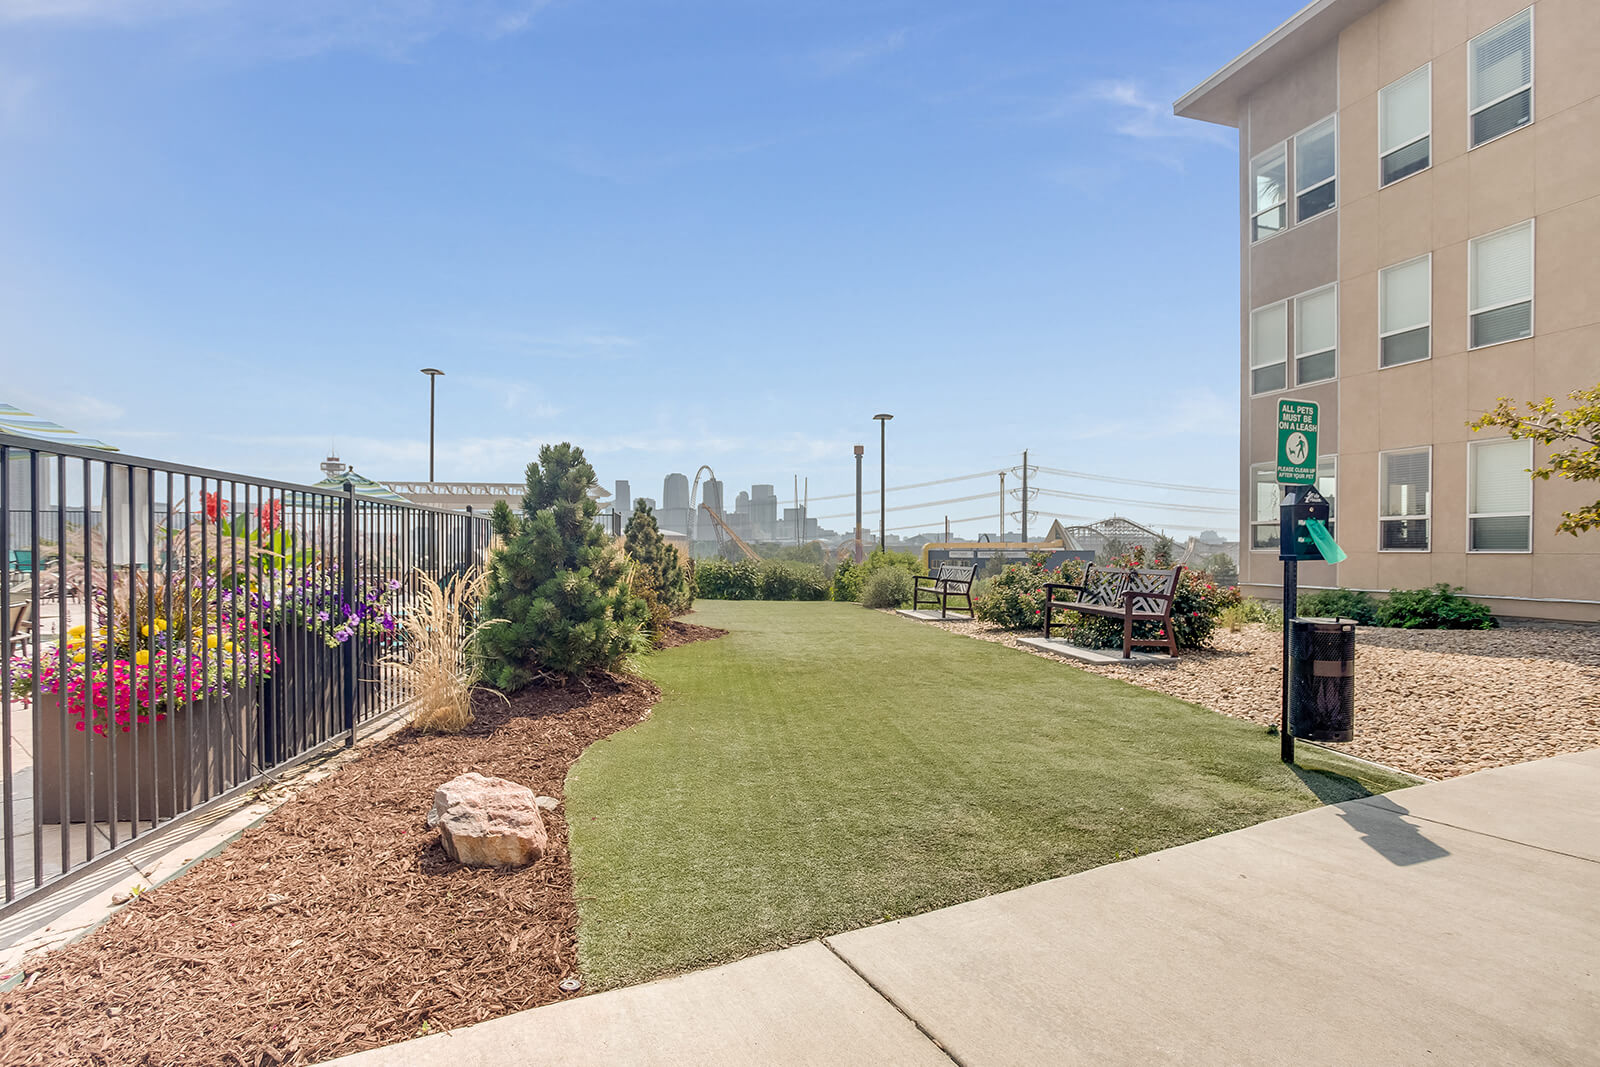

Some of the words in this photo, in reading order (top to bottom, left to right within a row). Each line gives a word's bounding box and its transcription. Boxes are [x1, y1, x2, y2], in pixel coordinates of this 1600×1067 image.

[1282, 404, 1295, 413] ALL
[1296, 406, 1314, 414] PETS
[1282, 413, 1301, 422] MUST
[1279, 421, 1289, 430] ON
[1296, 423, 1318, 432] LEASH
